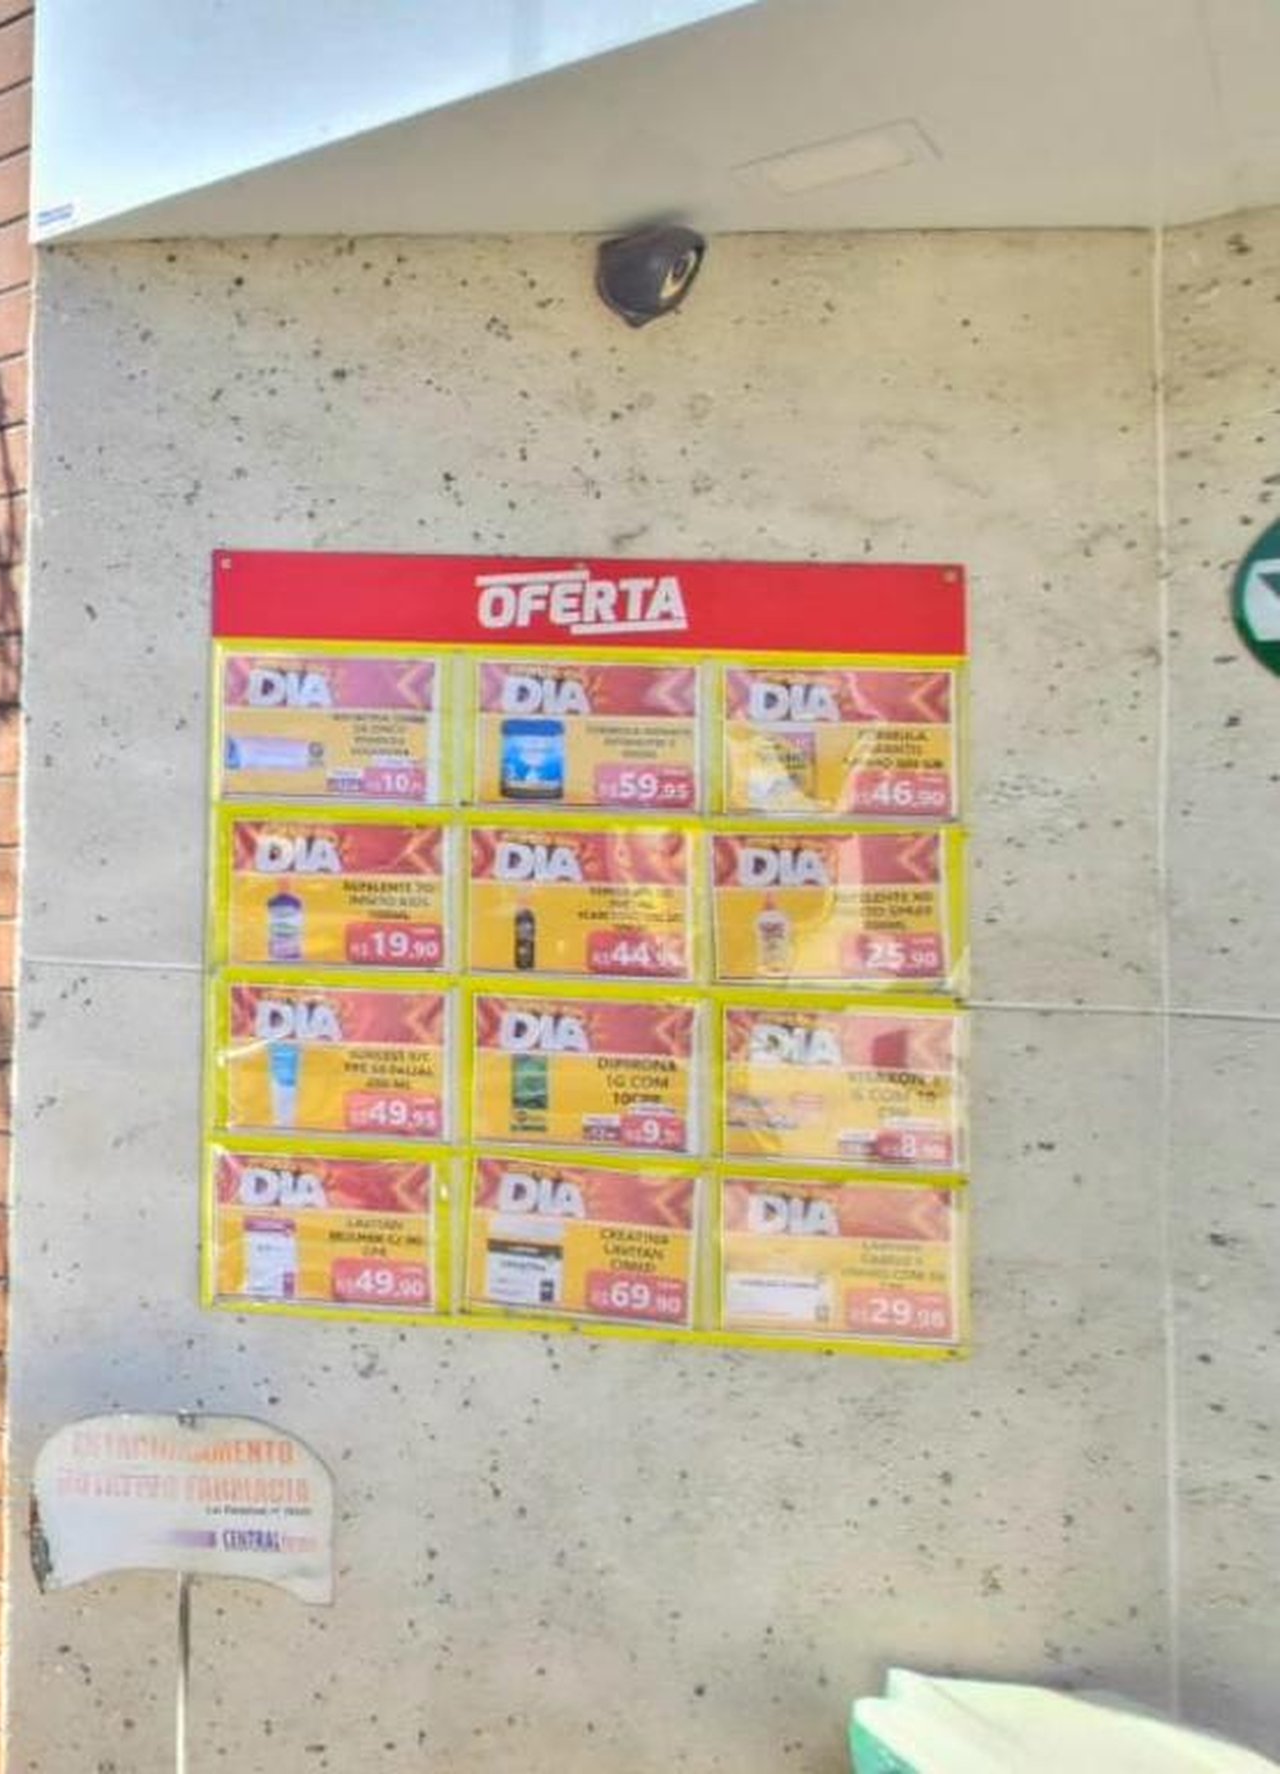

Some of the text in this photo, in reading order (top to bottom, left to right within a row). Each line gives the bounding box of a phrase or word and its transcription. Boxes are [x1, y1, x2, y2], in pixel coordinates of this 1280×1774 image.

[477, 575, 689, 630] OFERTA
[247, 668, 332, 707] DIA
[502, 673, 591, 714] DIA
[747, 681, 840, 722] DIA
[255, 836, 342, 873] DIA
[496, 843, 585, 882] DIA
[738, 847, 829, 887] DIA
[256, 999, 342, 1041] DIA
[500, 1010, 589, 1052] DIA
[748, 1022, 841, 1067] DIA
[239, 1166, 328, 1209] DIA
[498, 1172, 587, 1218] DIA
[748, 1193, 840, 1237] DIA
